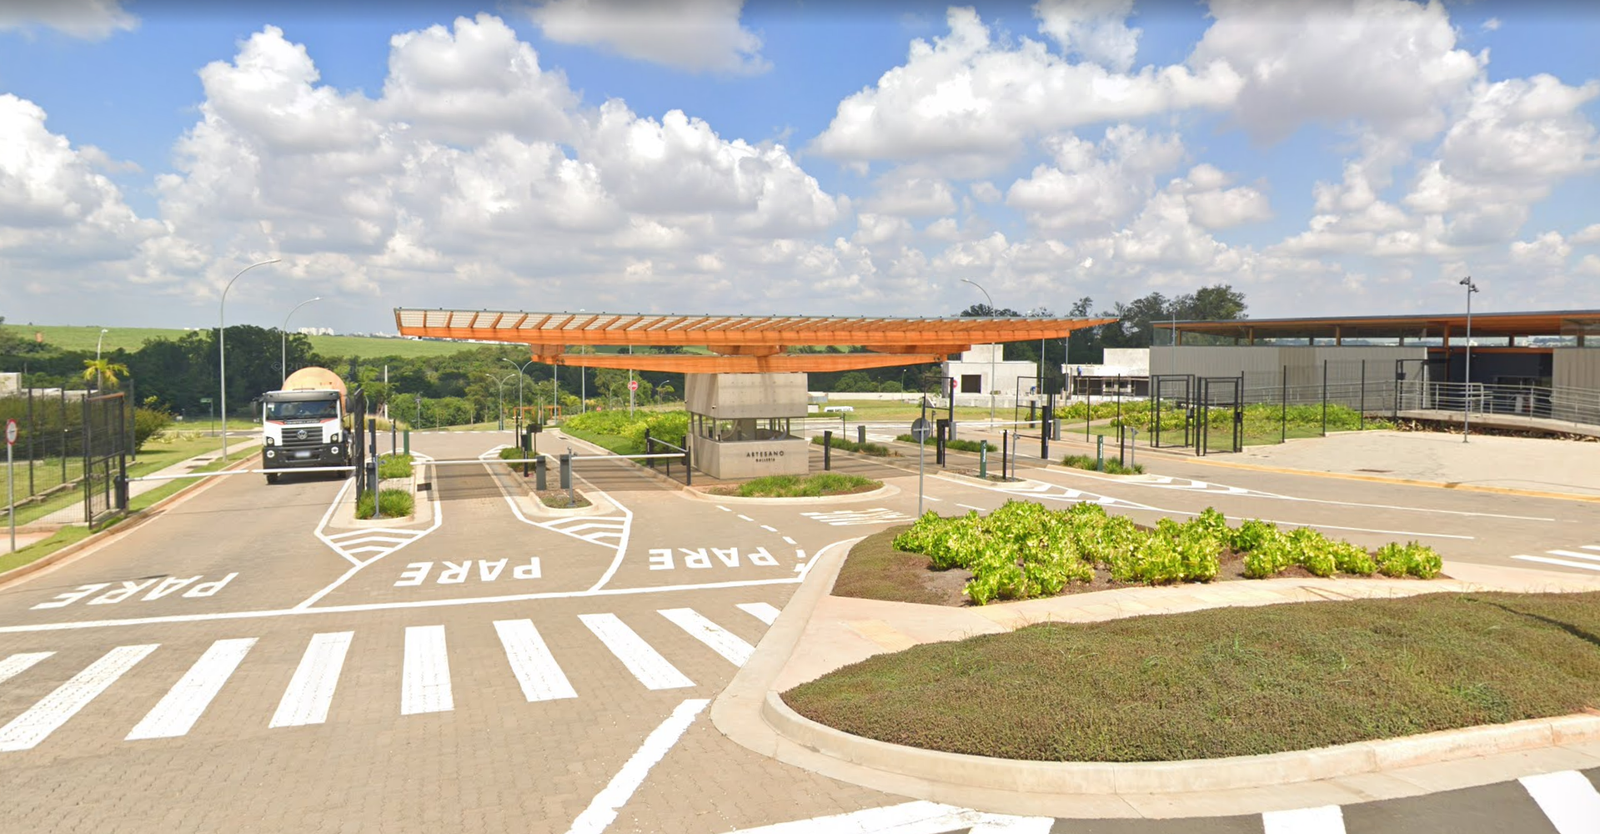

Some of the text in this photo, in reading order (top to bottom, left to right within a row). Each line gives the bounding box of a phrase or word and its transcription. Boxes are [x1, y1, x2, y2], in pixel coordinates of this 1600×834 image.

[746, 450, 785, 458] ARTESANO
[392, 555, 543, 588] PARE
[647, 545, 782, 571] PARE
[28, 571, 241, 611] PARE
